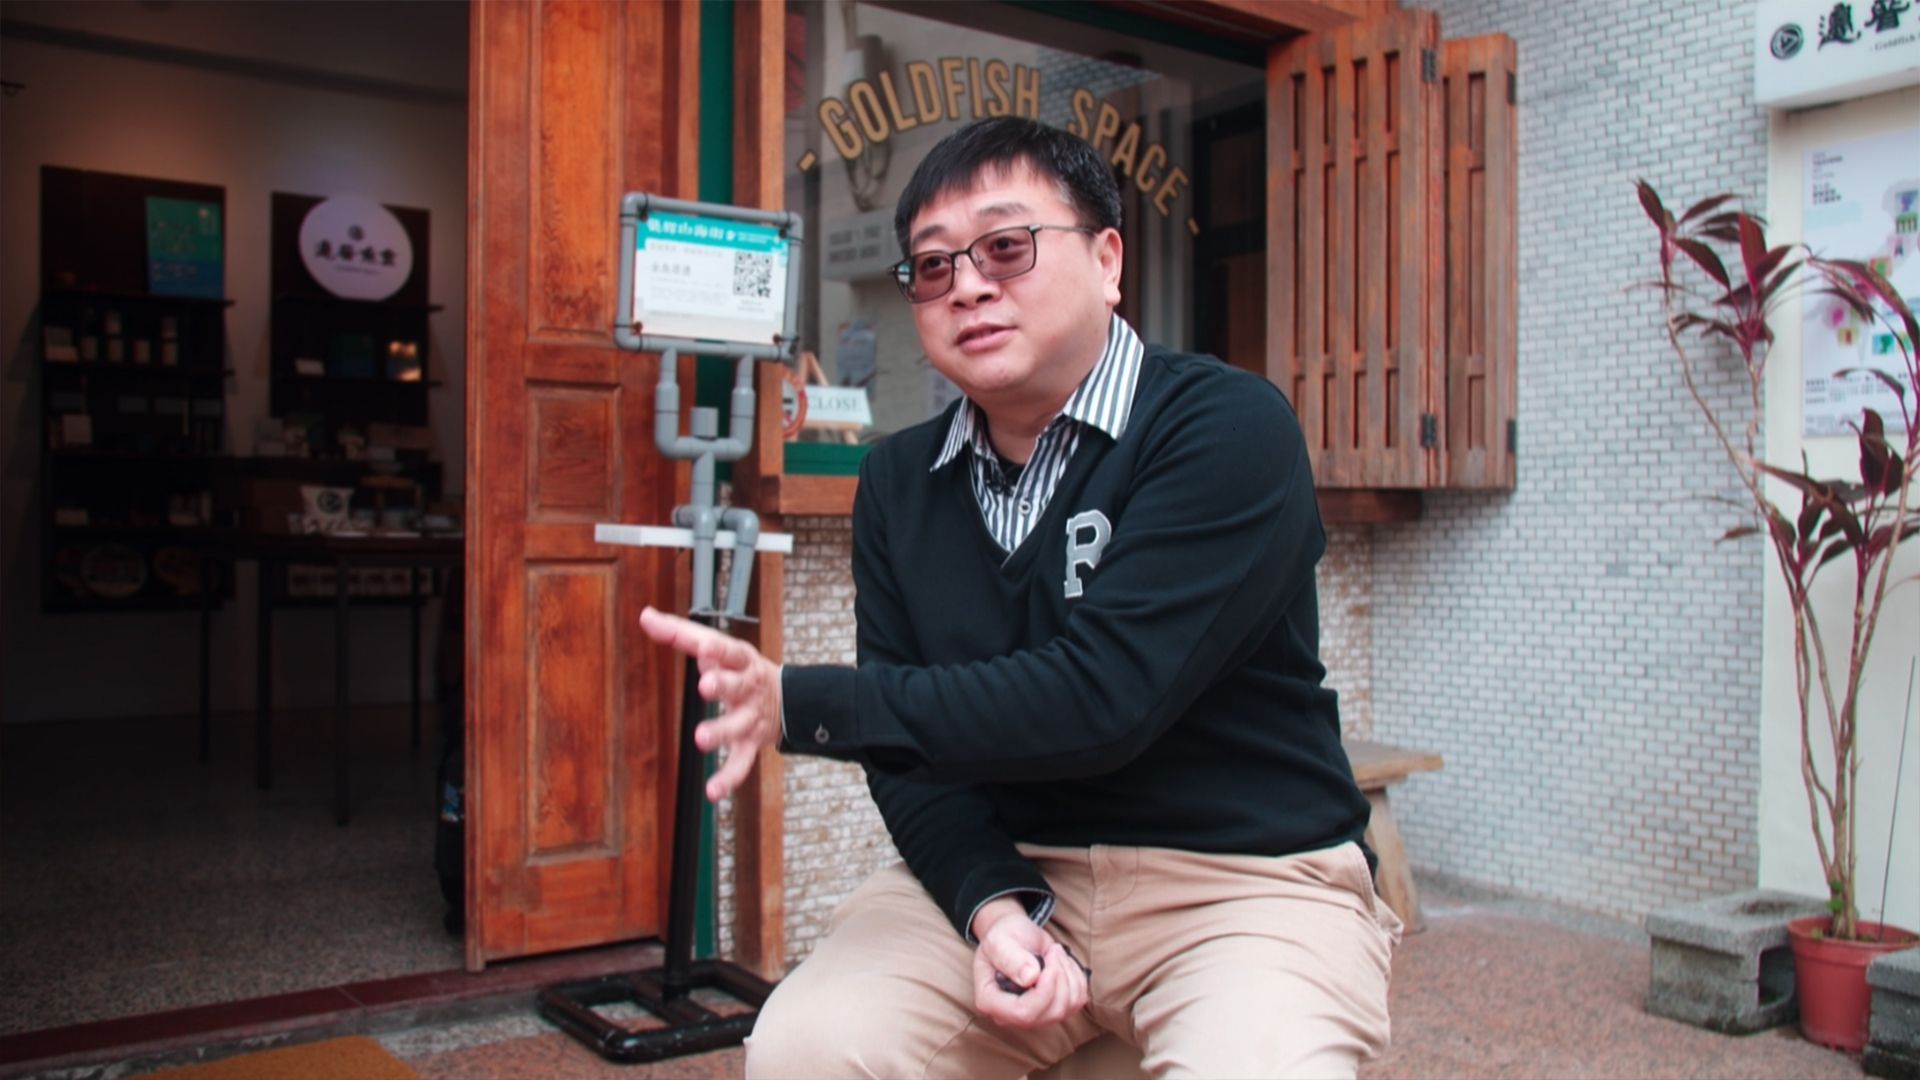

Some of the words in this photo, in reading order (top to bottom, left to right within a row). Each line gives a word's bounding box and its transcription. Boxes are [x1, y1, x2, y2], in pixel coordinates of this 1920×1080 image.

[818, 56, 1042, 161] GOLDFISH
[1066, 87, 1190, 217] SPACE
[1064, 509, 1112, 599] P
